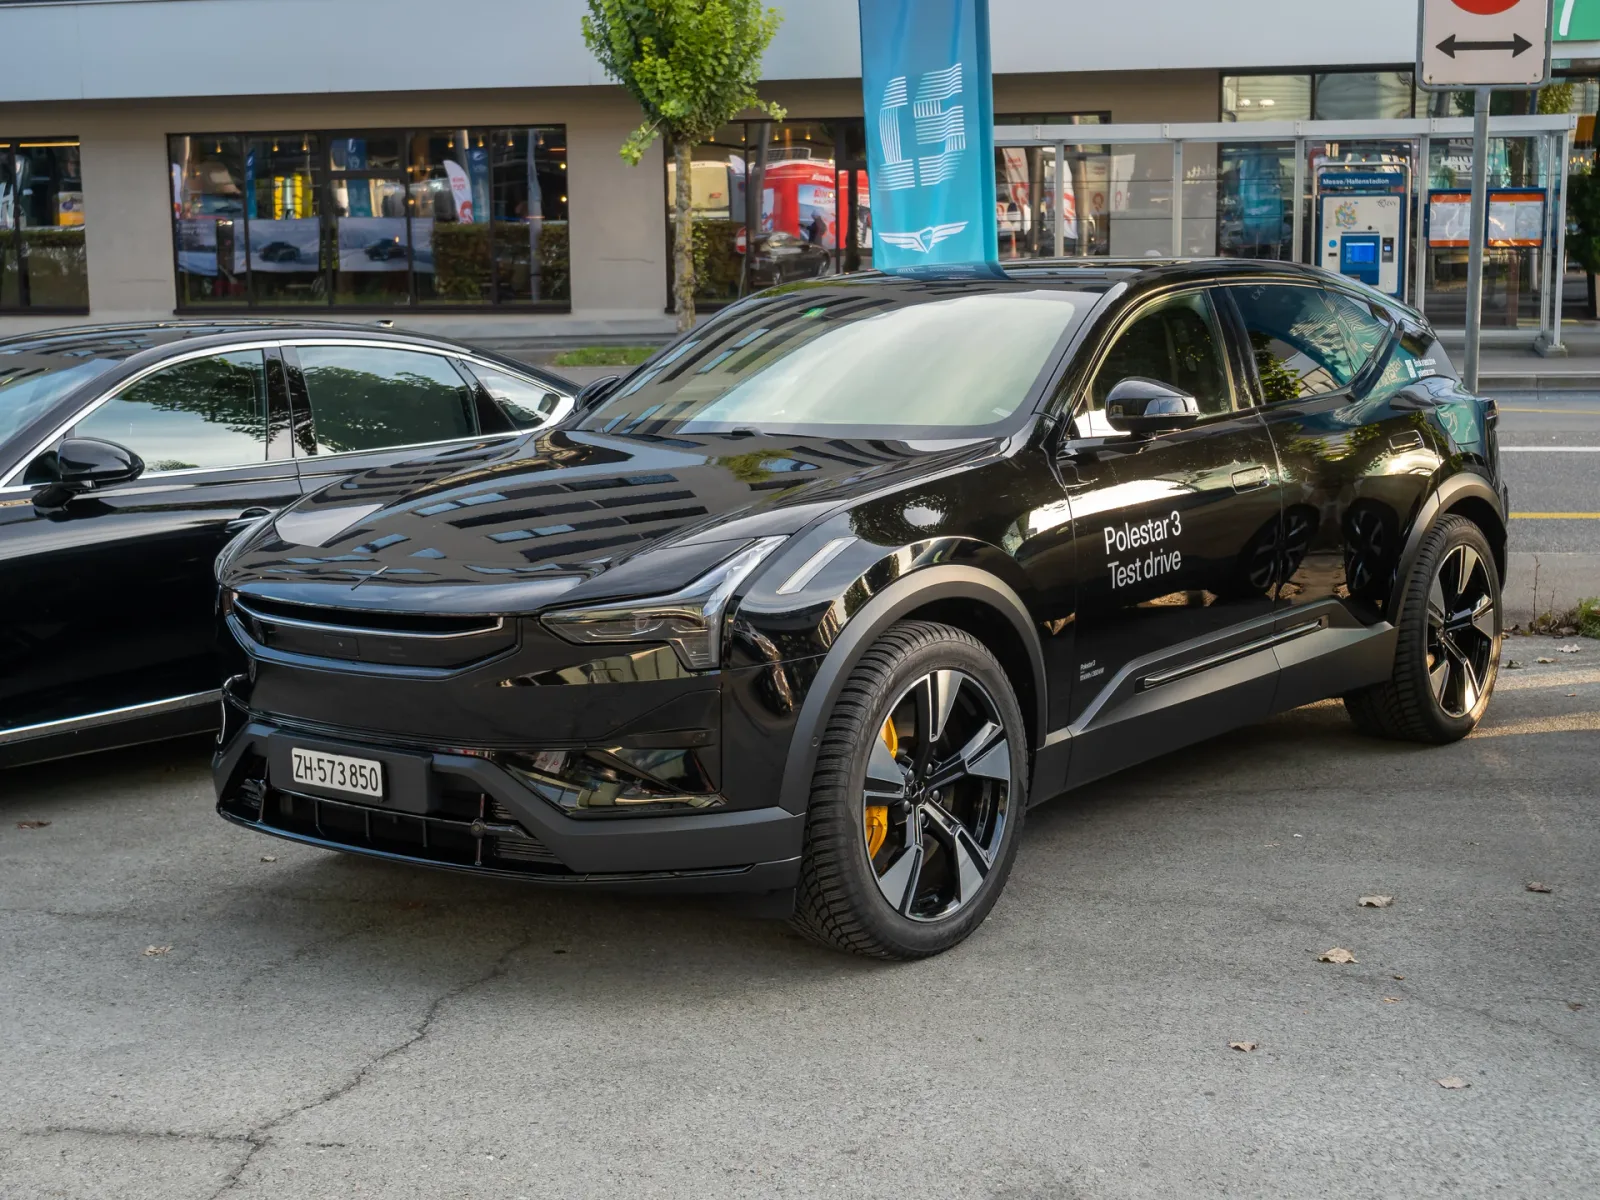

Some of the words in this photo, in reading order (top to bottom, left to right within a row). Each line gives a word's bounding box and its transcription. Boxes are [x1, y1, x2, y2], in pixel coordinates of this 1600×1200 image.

[1322, 178, 1390, 186] Messe/Hallenstadion
[1103, 517, 1169, 555] Polestar
[1170, 510, 1182, 536] 3
[1107, 557, 1142, 589] Test
[1144, 548, 1182, 579] drive
